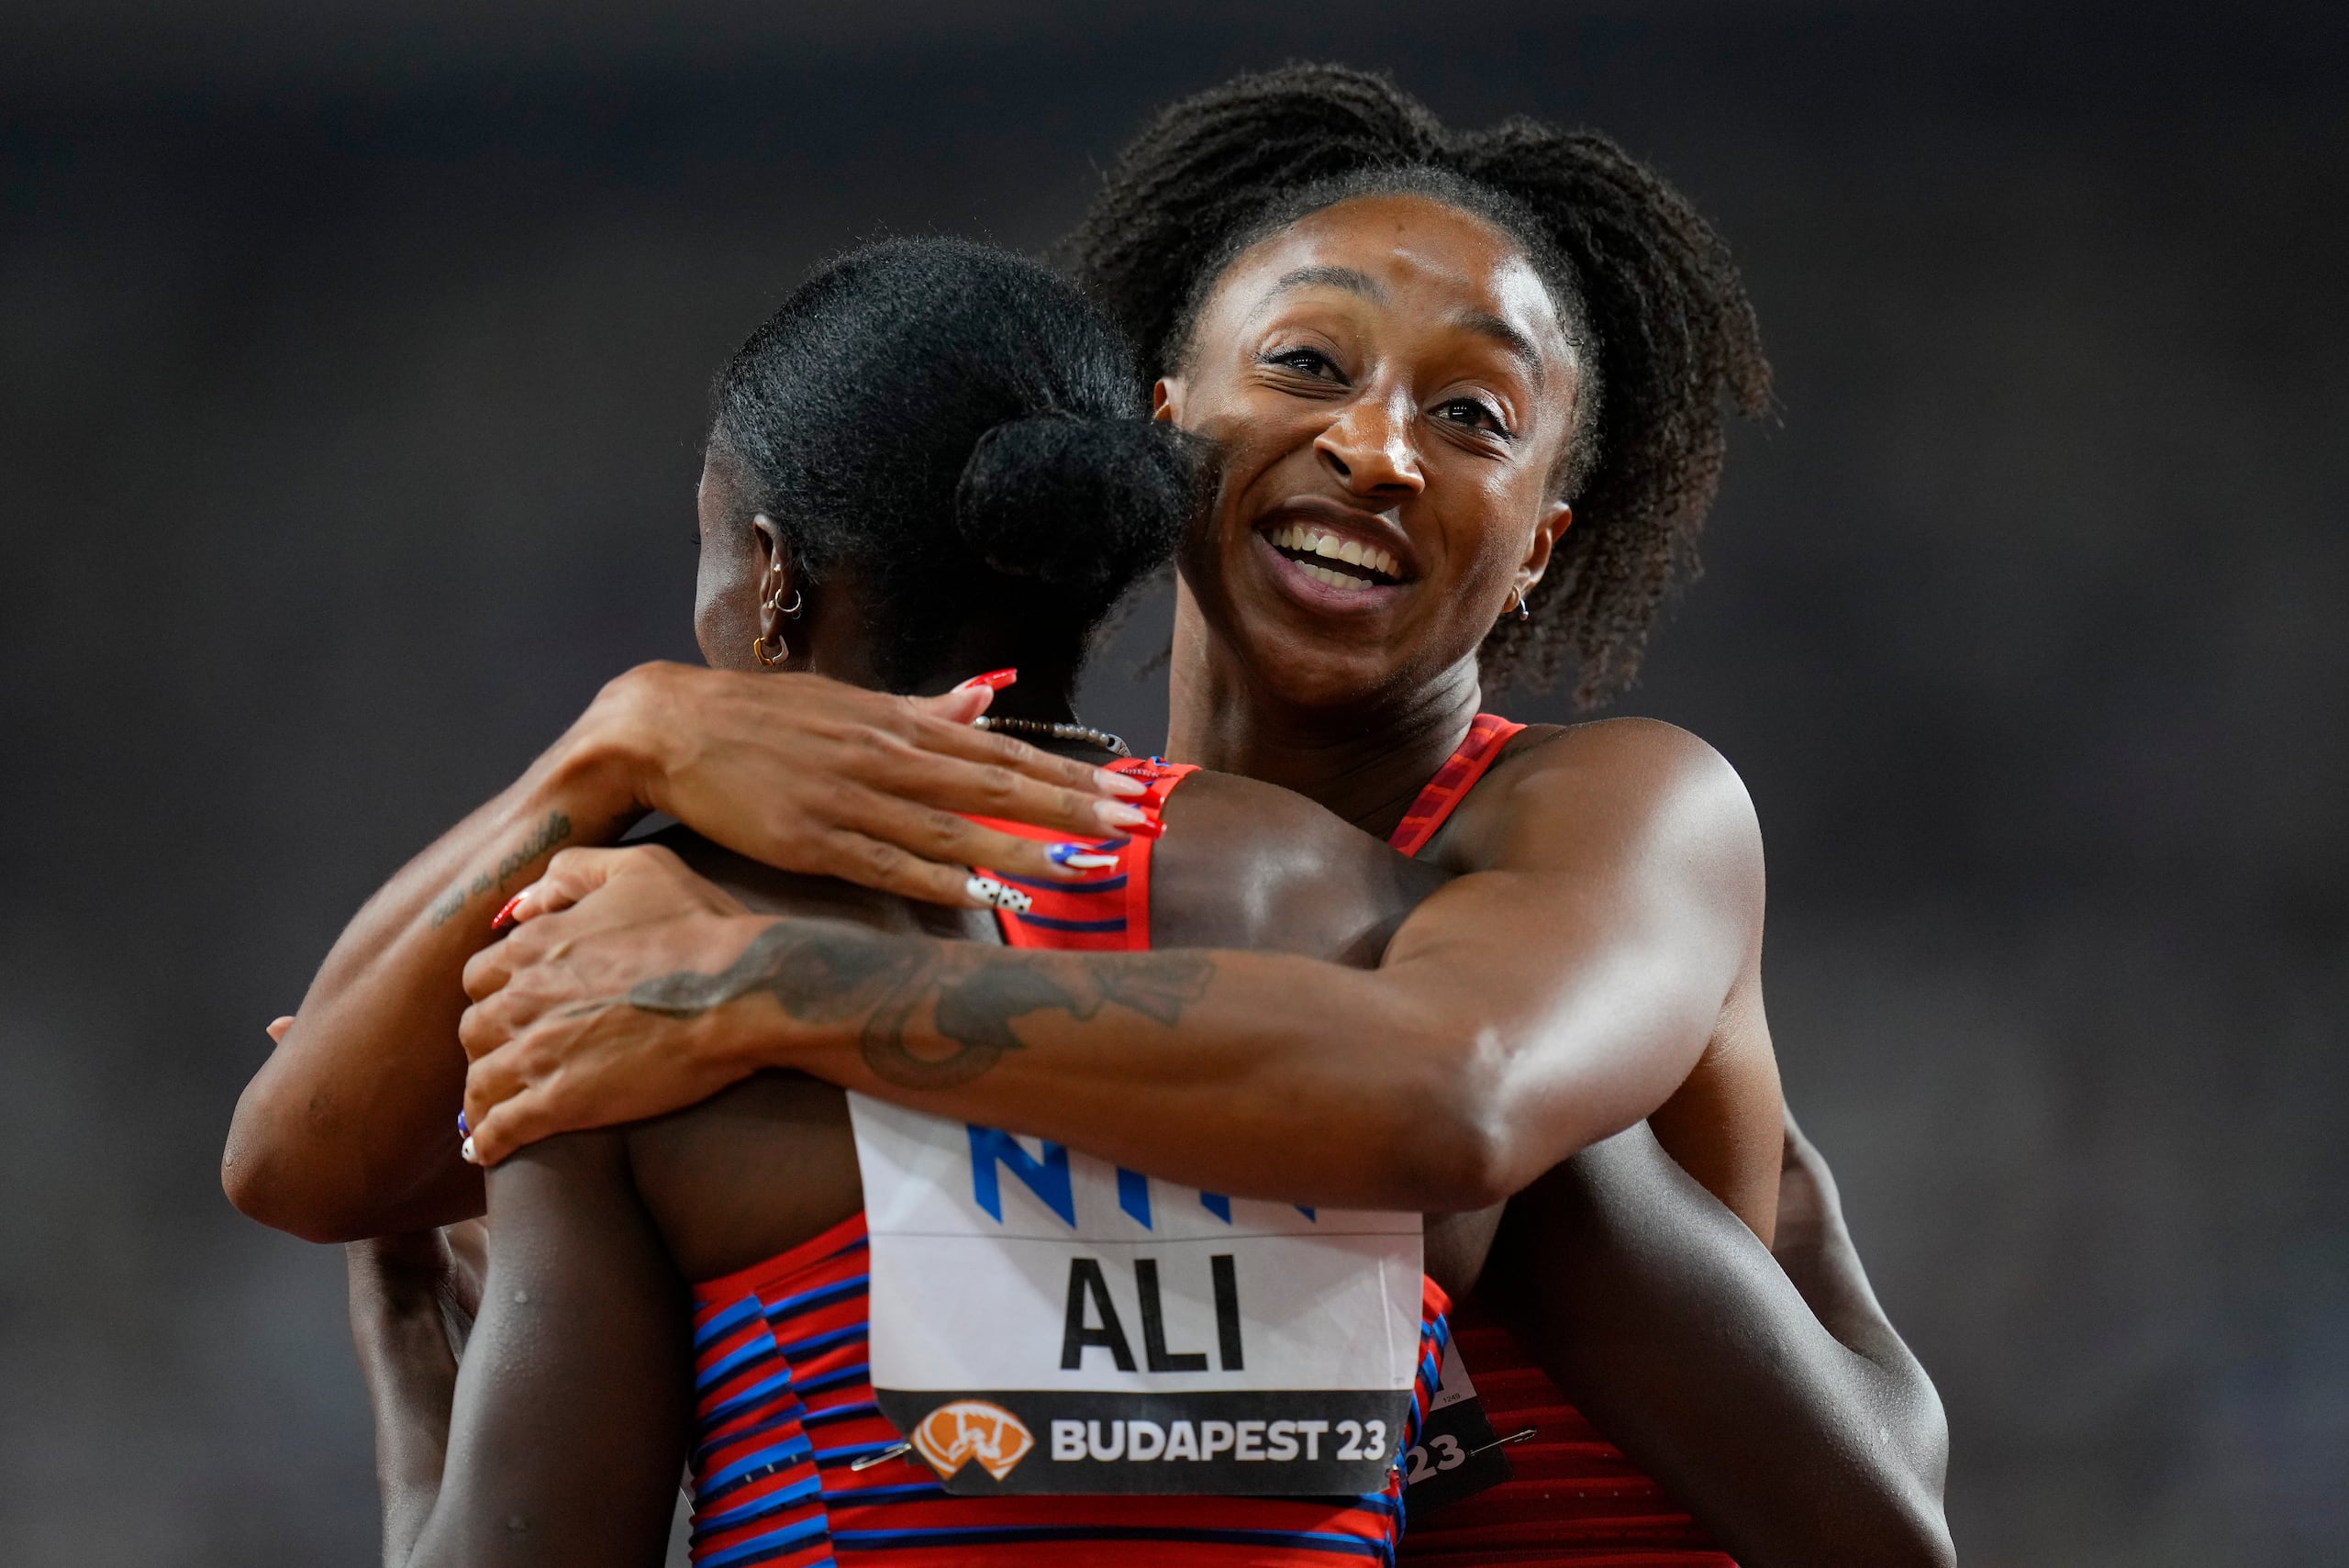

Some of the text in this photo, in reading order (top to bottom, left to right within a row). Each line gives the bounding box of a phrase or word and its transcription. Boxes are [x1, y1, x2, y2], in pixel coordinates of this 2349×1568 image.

[1060, 1253, 1244, 1373] ALI
[1051, 1419, 1386, 1462] BUDAPEST 23
[1406, 1434, 1466, 1485] 23
